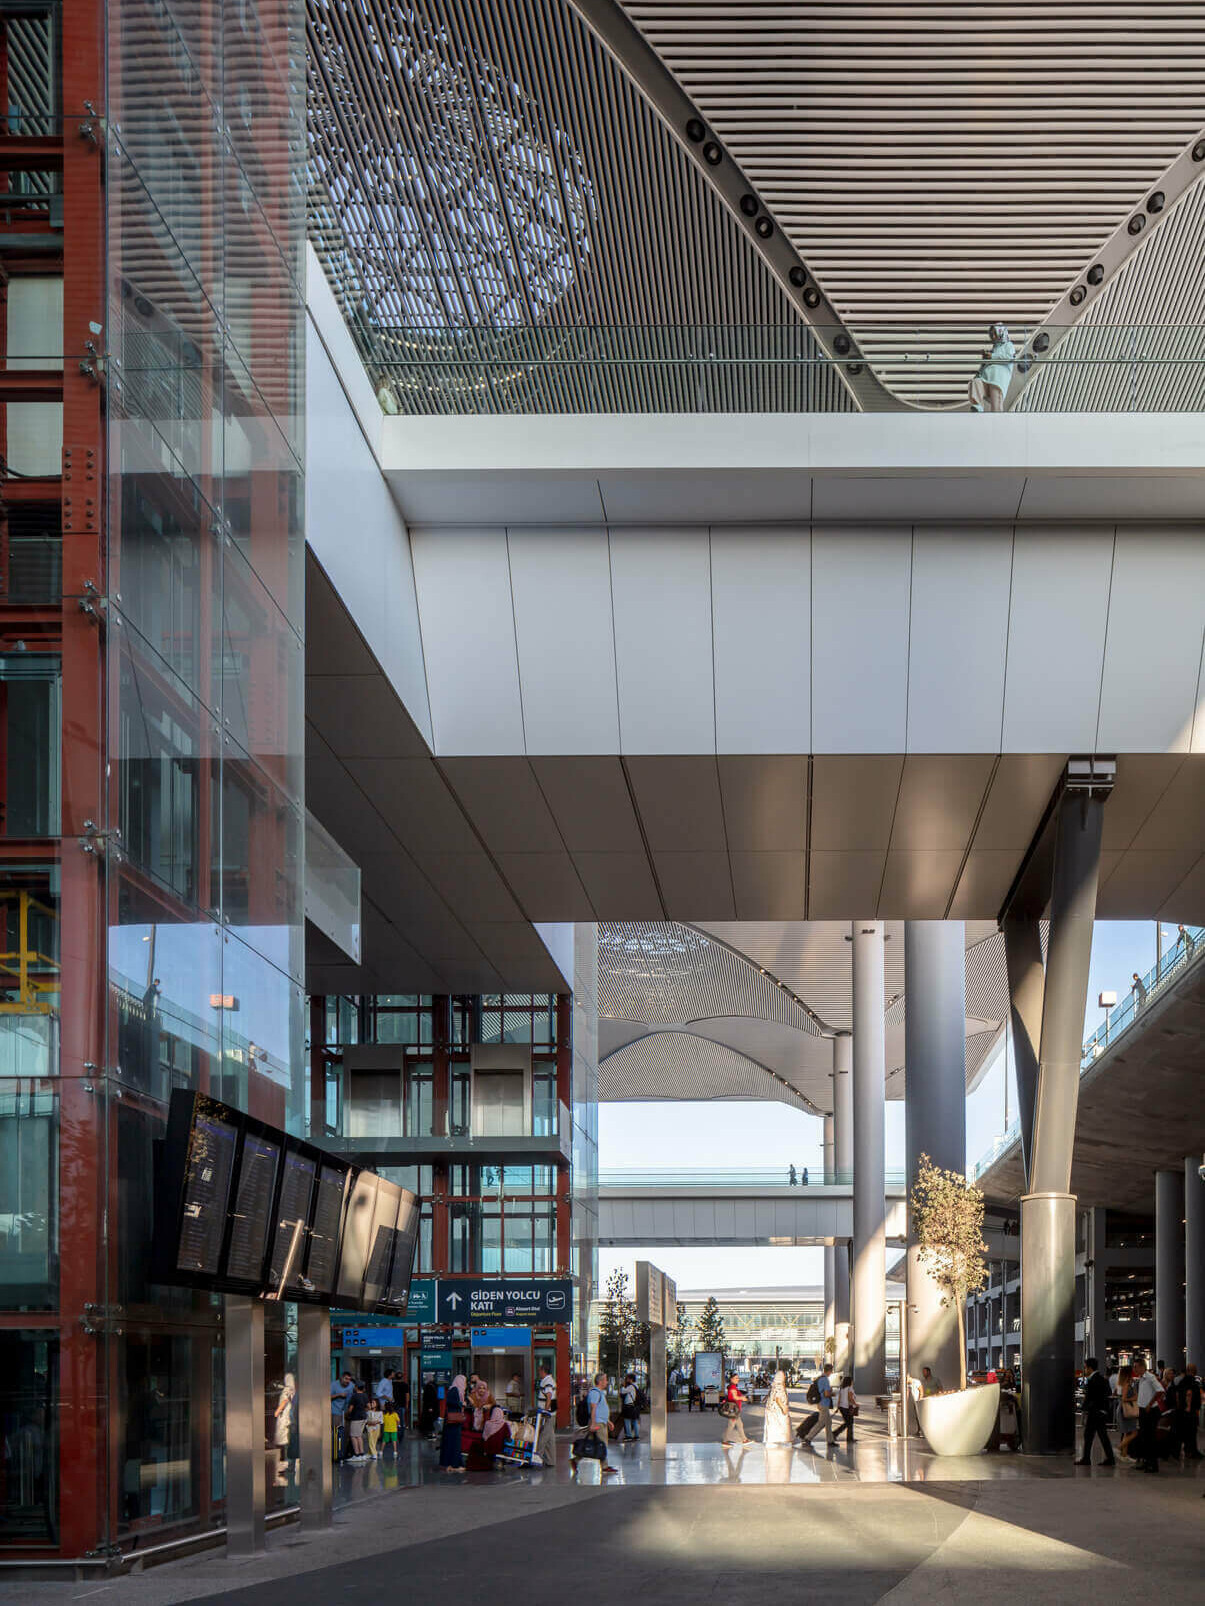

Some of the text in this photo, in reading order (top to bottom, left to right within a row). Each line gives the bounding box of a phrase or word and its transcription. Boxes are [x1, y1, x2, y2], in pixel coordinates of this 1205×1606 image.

[471, 1290, 540, 1300] GİDEN YOLCU
[471, 1301, 493, 1310] KATI
